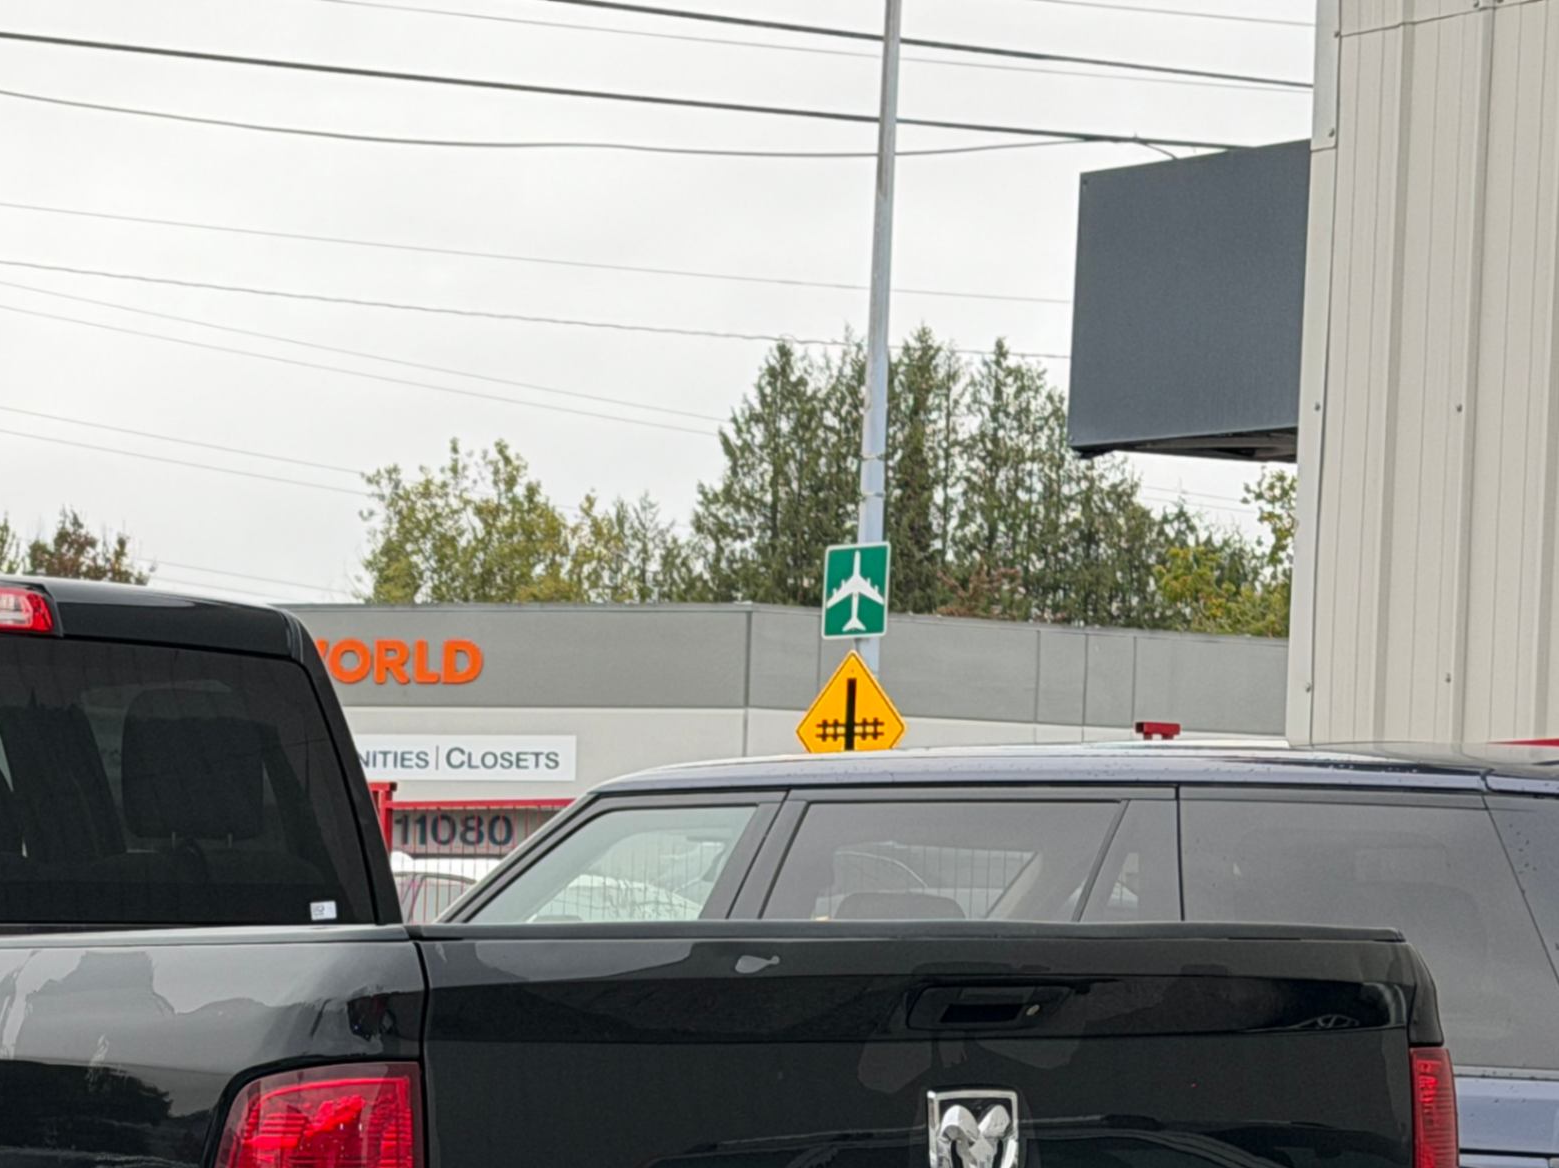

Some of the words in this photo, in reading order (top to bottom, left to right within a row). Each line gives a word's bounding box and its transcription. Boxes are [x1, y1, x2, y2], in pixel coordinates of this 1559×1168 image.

[315, 636, 483, 685] ORLD
[445, 746, 560, 771] CLOSETS
[395, 814, 513, 847] 11080
